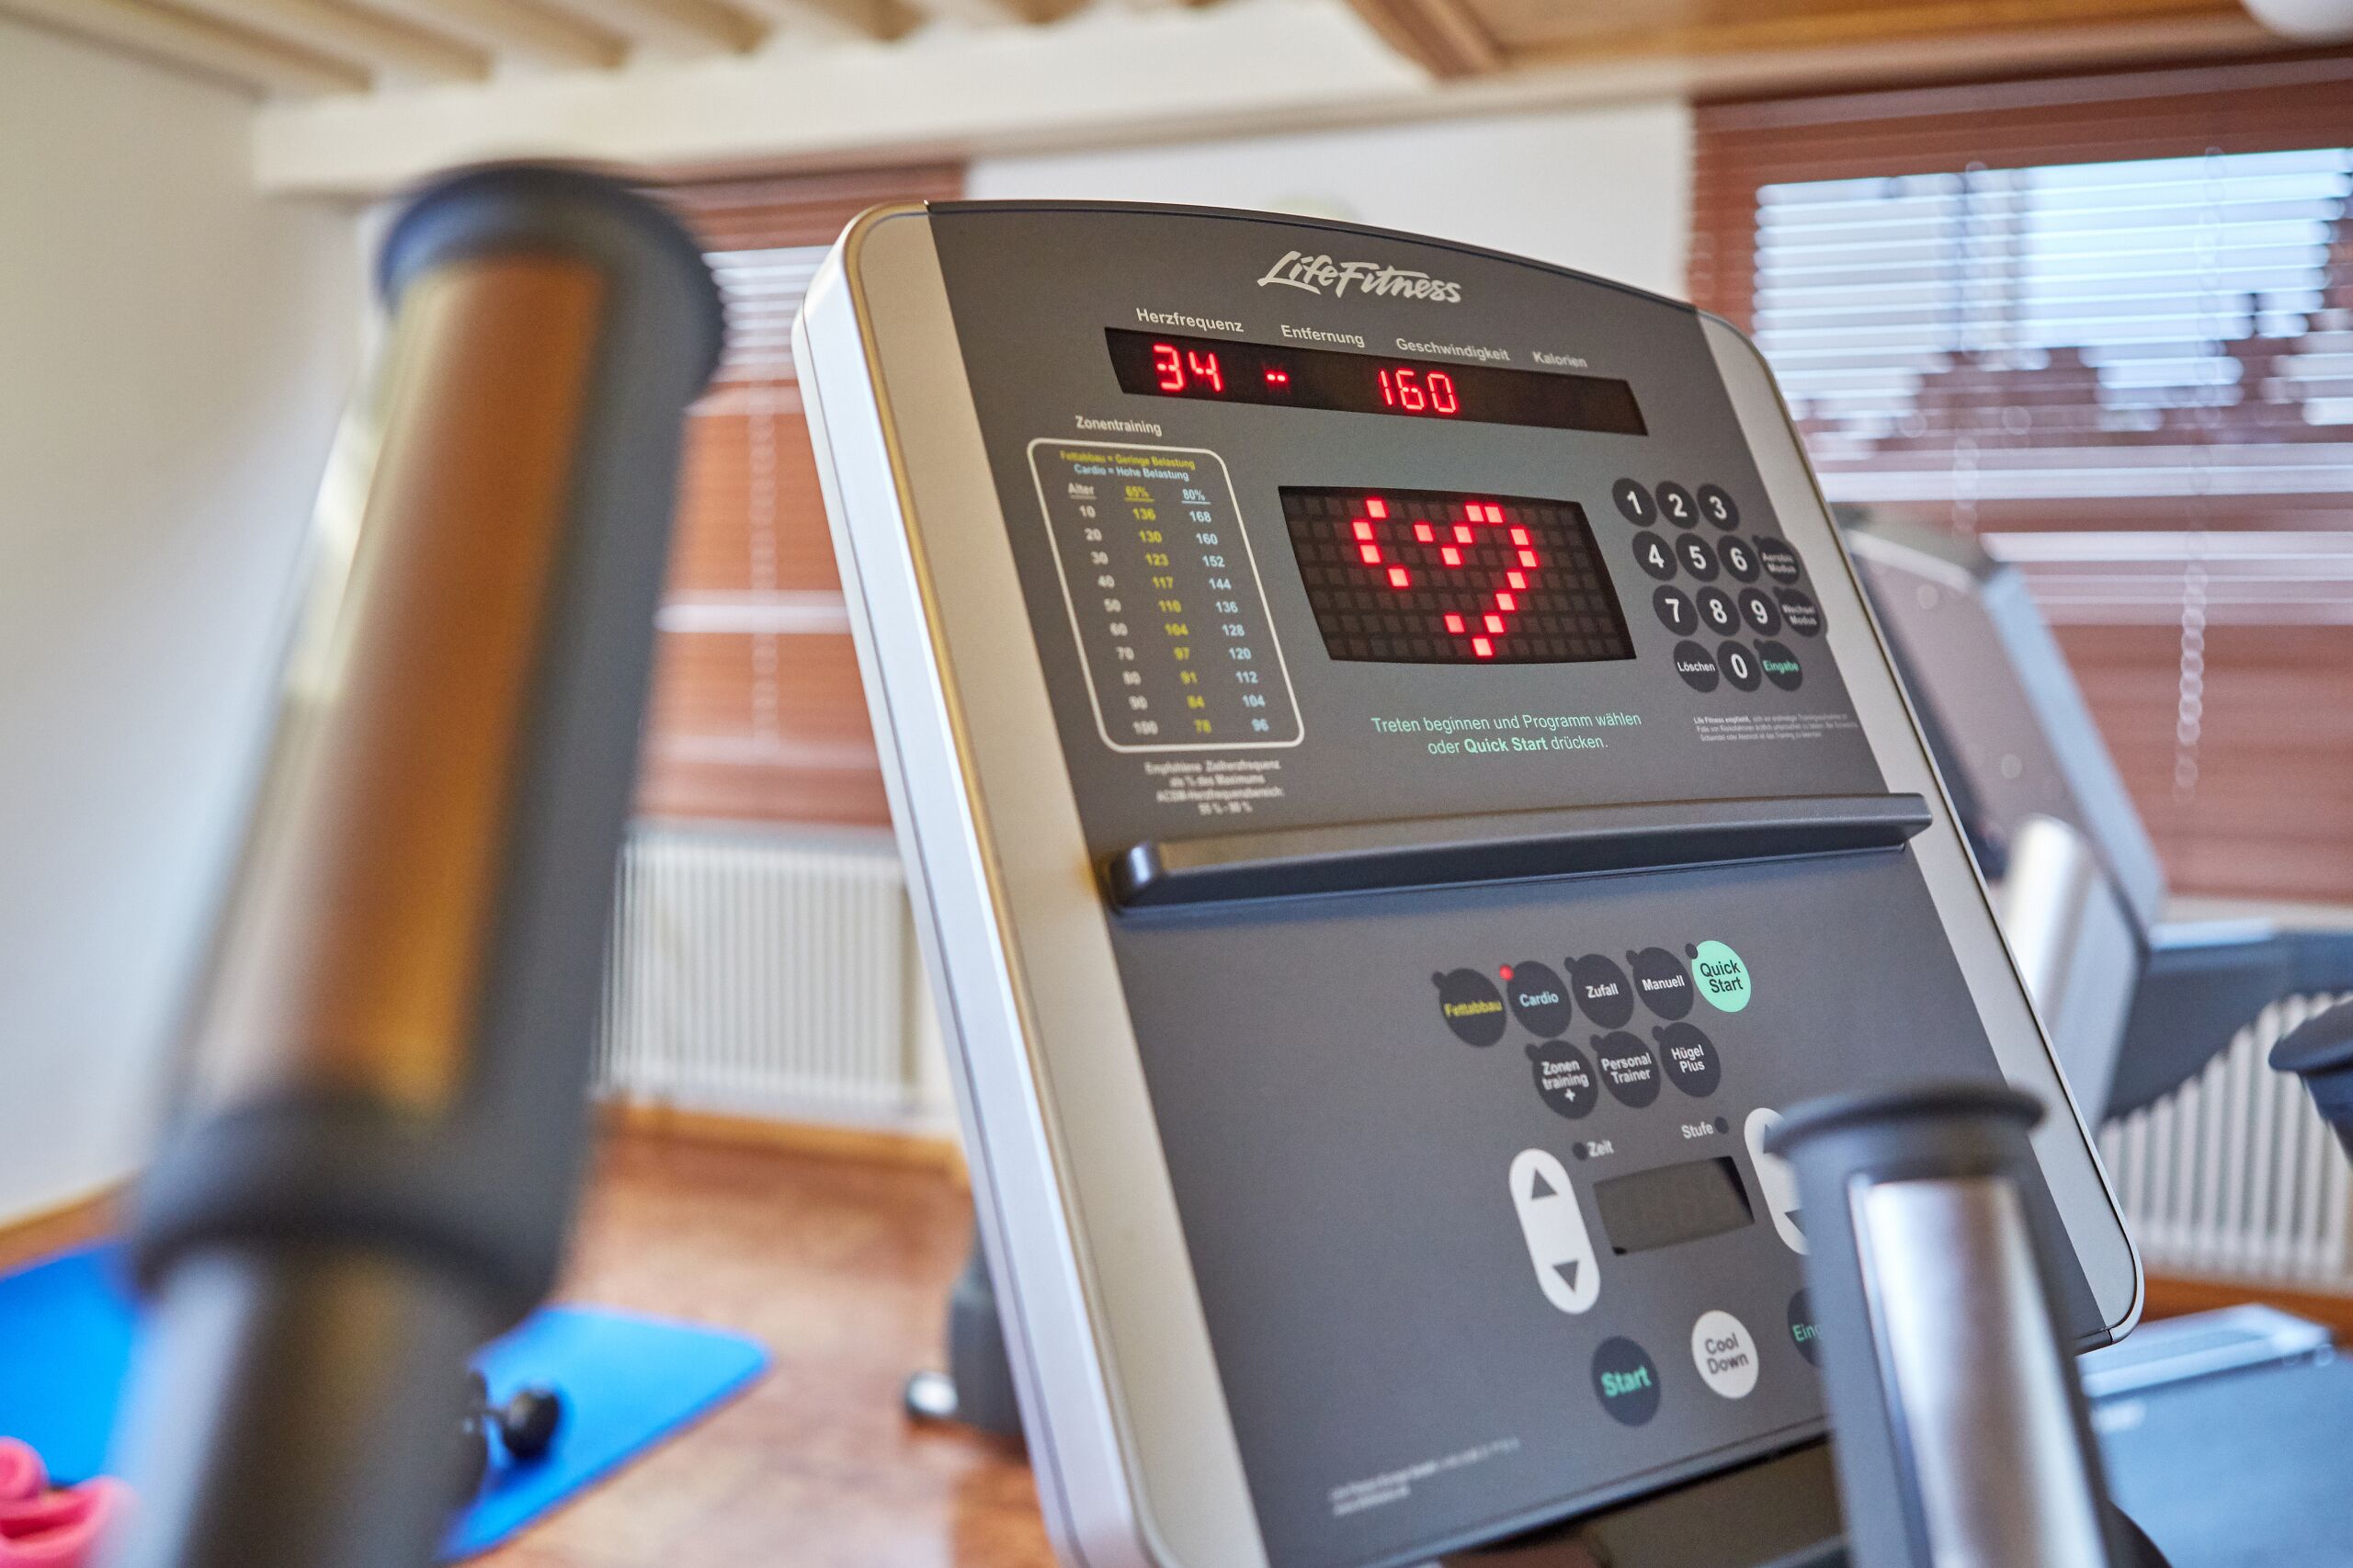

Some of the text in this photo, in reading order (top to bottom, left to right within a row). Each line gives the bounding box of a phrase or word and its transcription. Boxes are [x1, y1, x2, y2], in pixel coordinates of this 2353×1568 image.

[1136, 308, 1245, 334] Herzfrequenz
[1281, 324, 1365, 348] Entfernung
[1395, 337, 1510, 362] Geschwindigkeit
[1532, 351, 1587, 369] Kalorien
[1154, 345, 1222, 392] 34
[1380, 369, 1457, 414] 160
[1075, 415, 1163, 437] Zonentraining
[1151, 456, 1196, 470] Belastung
[1074, 463, 1107, 475] Cardio
[1116, 466, 1142, 478] Hohe
[1142, 467, 1189, 482] Belastung
[1068, 482, 1095, 495] Alter
[1182, 489, 1206, 501] 80%
[1627, 491, 1643, 515] 1
[1668, 494, 1688, 517] 2
[1710, 496, 1727, 520] 3
[1079, 506, 1211, 523] 10 136 168
[1085, 528, 1218, 545] 20 130 160
[1145, 553, 1169, 567] 123
[1202, 555, 1225, 568] 152
[1649, 544, 1665, 568] 4
[1689, 546, 1707, 570] 5
[1731, 547, 1748, 572] 6
[1097, 575, 1232, 590] 40 117 144
[1158, 600, 1182, 613] 110
[1215, 601, 1238, 613] 136
[1665, 598, 1680, 623] 7
[1710, 599, 1728, 624] 8
[1750, 599, 1768, 624] 9
[1789, 615, 1818, 625] Modus
[1222, 624, 1245, 637] 128
[1173, 647, 1190, 660] 97
[1229, 648, 1252, 660] 120
[1677, 659, 1716, 673] Löschen
[1731, 653, 1748, 678] 0
[1762, 659, 1799, 674] Eingabe
[1235, 672, 1258, 684] 112
[1242, 695, 1266, 708] 104
[1252, 719, 1268, 732] 96
[1370, 711, 1642, 734] Treten beginnen und Programm wählen
[1427, 734, 1608, 755] oder Quick Start drücken.
[1700, 960, 1741, 978] Quick
[1586, 983, 1619, 999] Zufall
[1642, 974, 1686, 991] Manuell
[1709, 978, 1744, 994] Start
[1518, 992, 1559, 1007] Cardio
[1443, 1000, 1503, 1018] Fettabbau
[1601, 1052, 1653, 1072] Personal
[1671, 1044, 1704, 1062] Hügel
[1541, 1059, 1581, 1076] Zonen
[1679, 1060, 1706, 1074] Plus
[1541, 1074, 1590, 1091] training
[1609, 1069, 1652, 1085] Trainer
[1680, 1122, 1714, 1140] Stufe
[1586, 1140, 1615, 1158] Zeit
[1704, 1331, 1739, 1354] Cool
[1707, 1353, 1749, 1375] Down
[1601, 1365, 1653, 1398] Start
